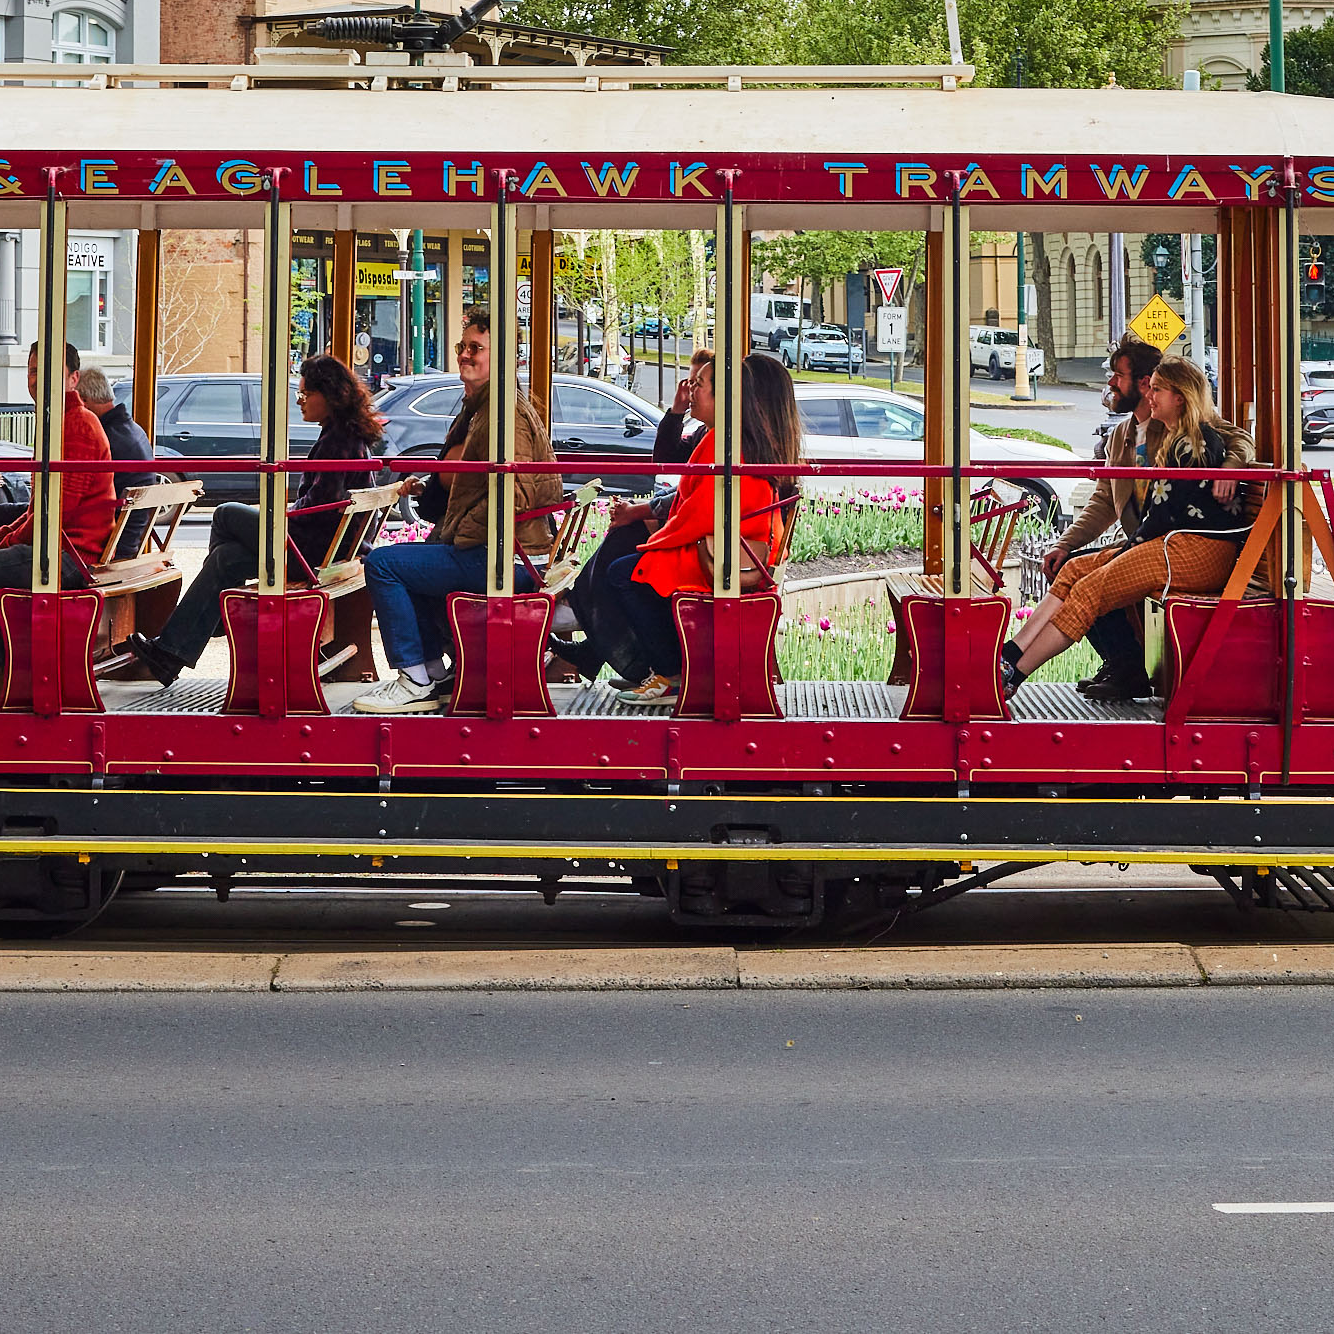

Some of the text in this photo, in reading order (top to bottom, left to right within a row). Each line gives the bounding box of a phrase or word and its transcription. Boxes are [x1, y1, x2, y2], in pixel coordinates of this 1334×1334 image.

[80, 159, 713, 197] EAGLEHAWK
[292, 235, 315, 244] OTWEAR
[67, 242, 98, 254] NDIGO
[68, 254, 105, 267] EATIVE
[1147, 311, 1168, 319] LEFT
[889, 322, 893, 335] 1
[1146, 322, 1168, 330] LANE
[1147, 333, 1170, 341] ENDS
